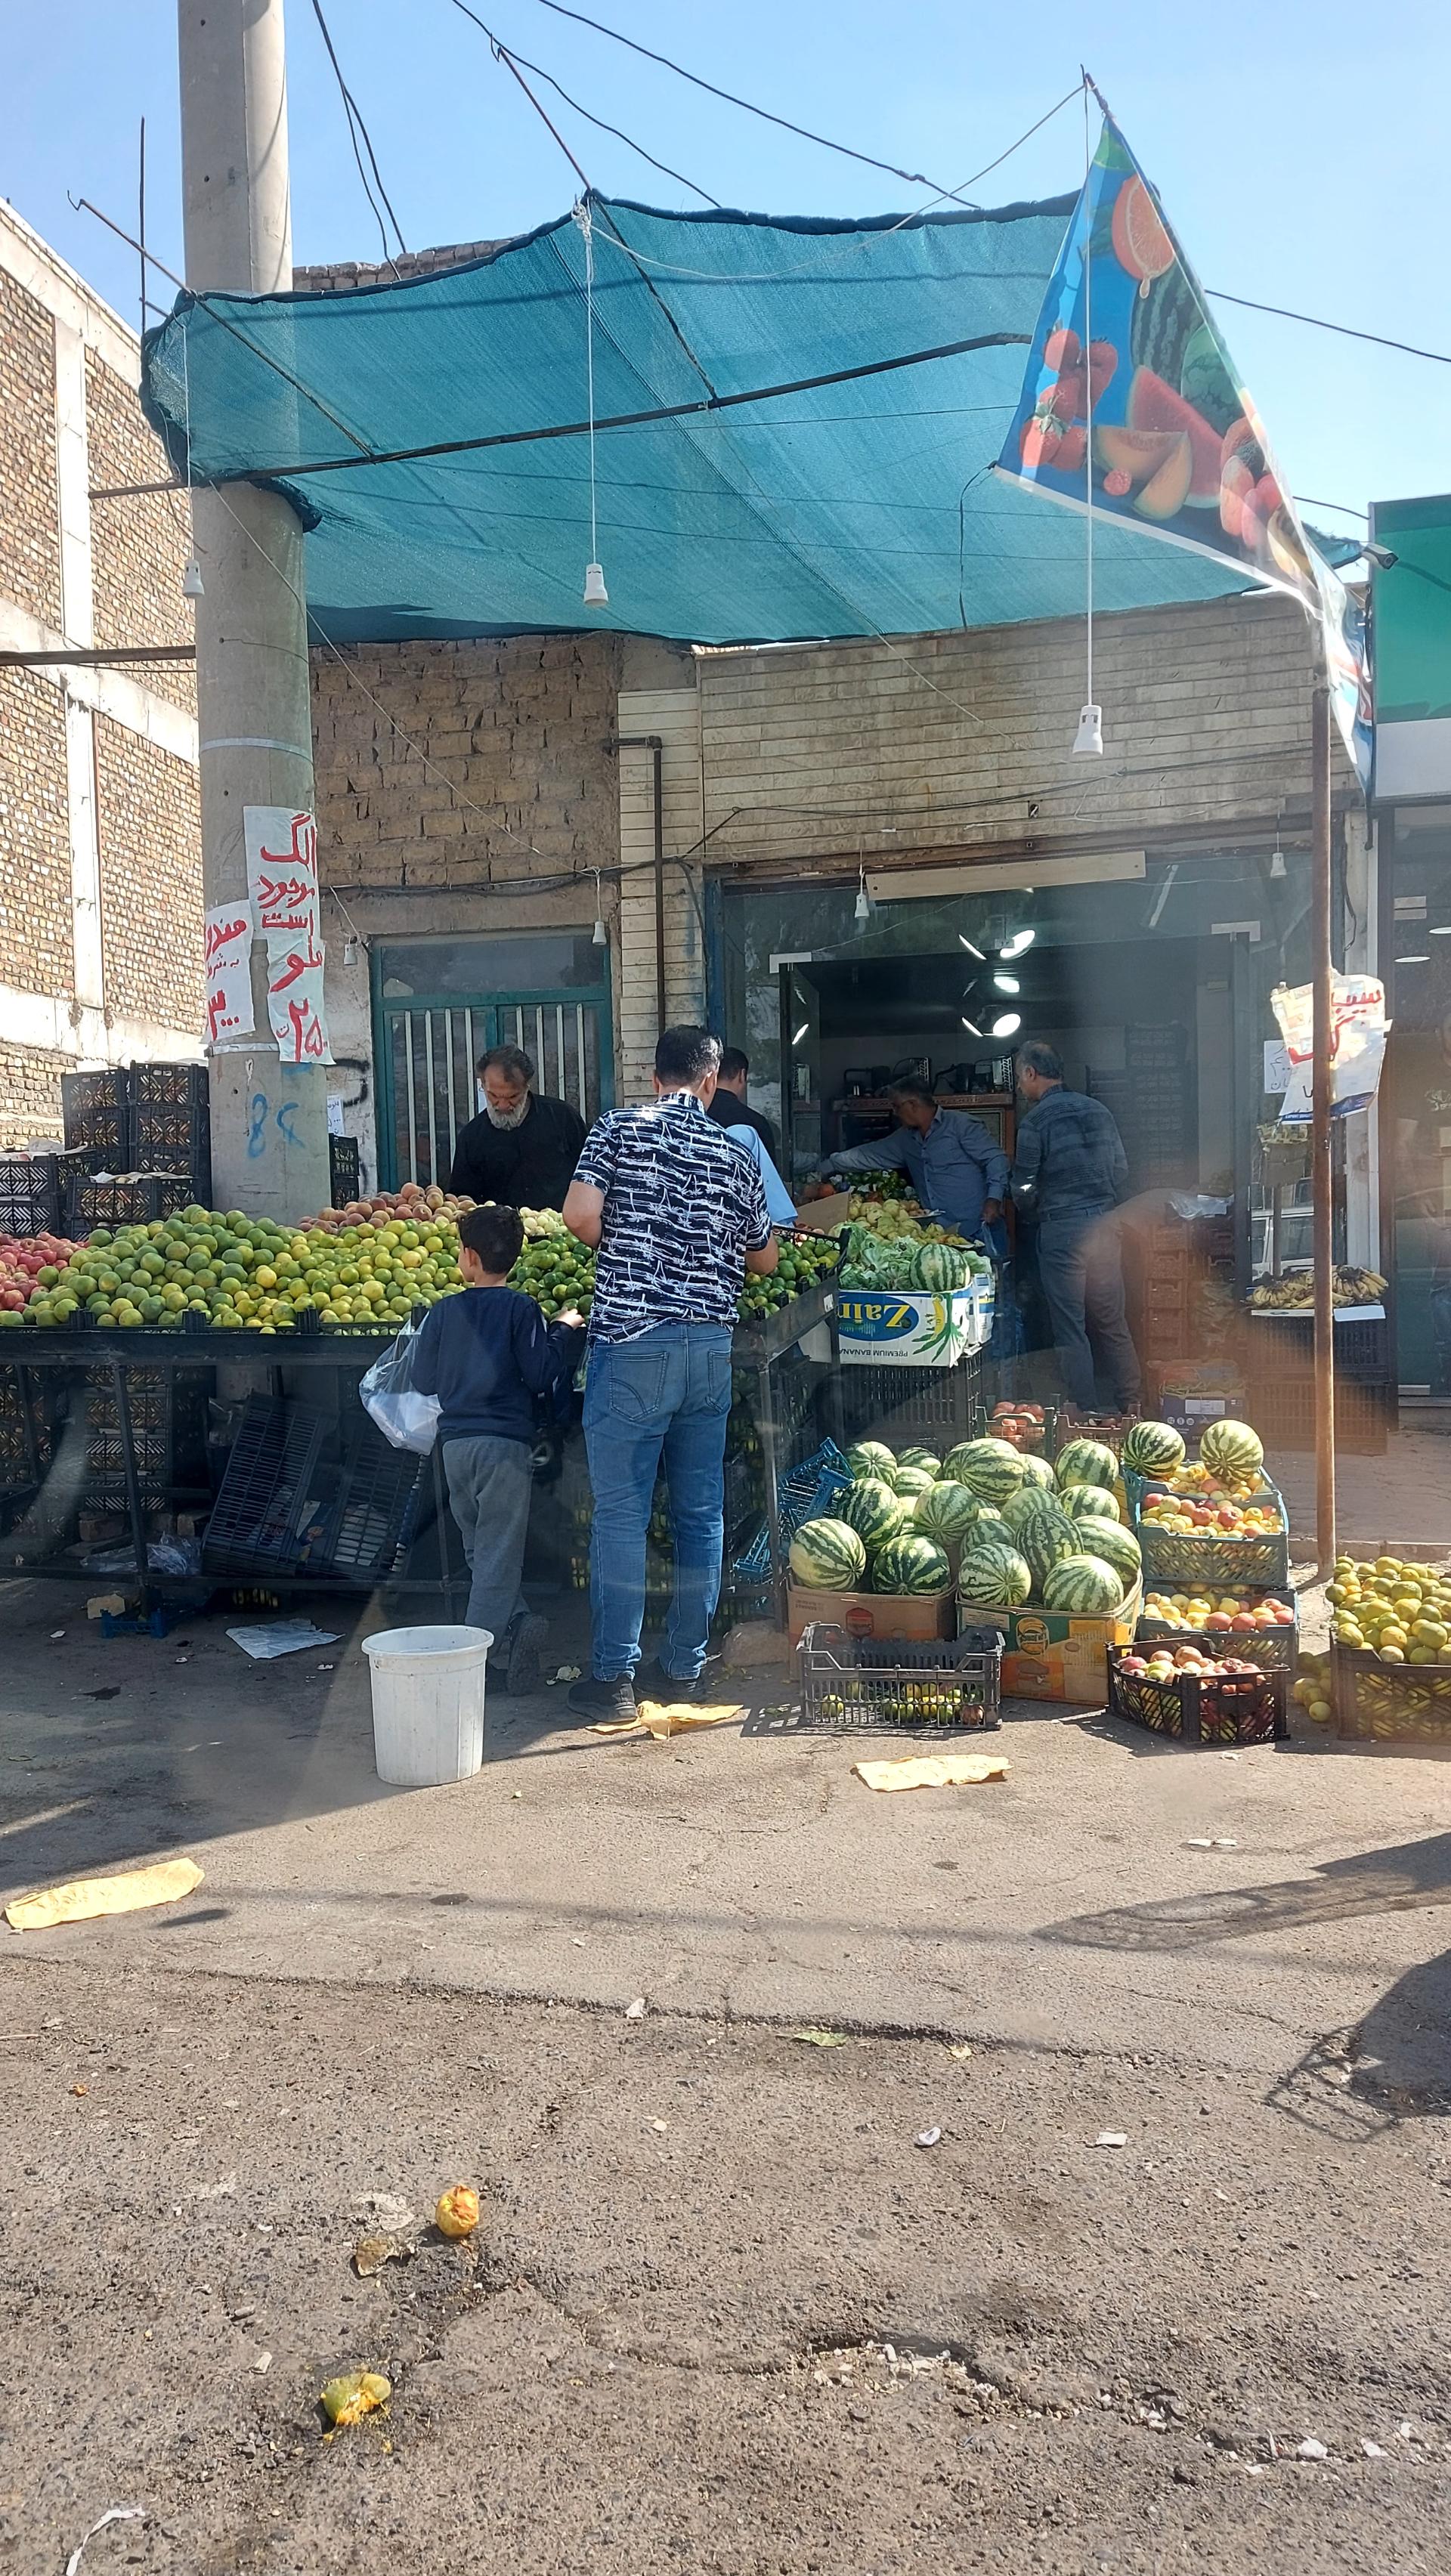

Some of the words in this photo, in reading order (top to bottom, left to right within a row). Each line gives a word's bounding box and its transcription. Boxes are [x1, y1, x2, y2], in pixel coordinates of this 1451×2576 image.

[257, 874, 316, 909] موجود
[261, 909, 314, 936] است
[874, 1349, 908, 1357] PREMIUM
